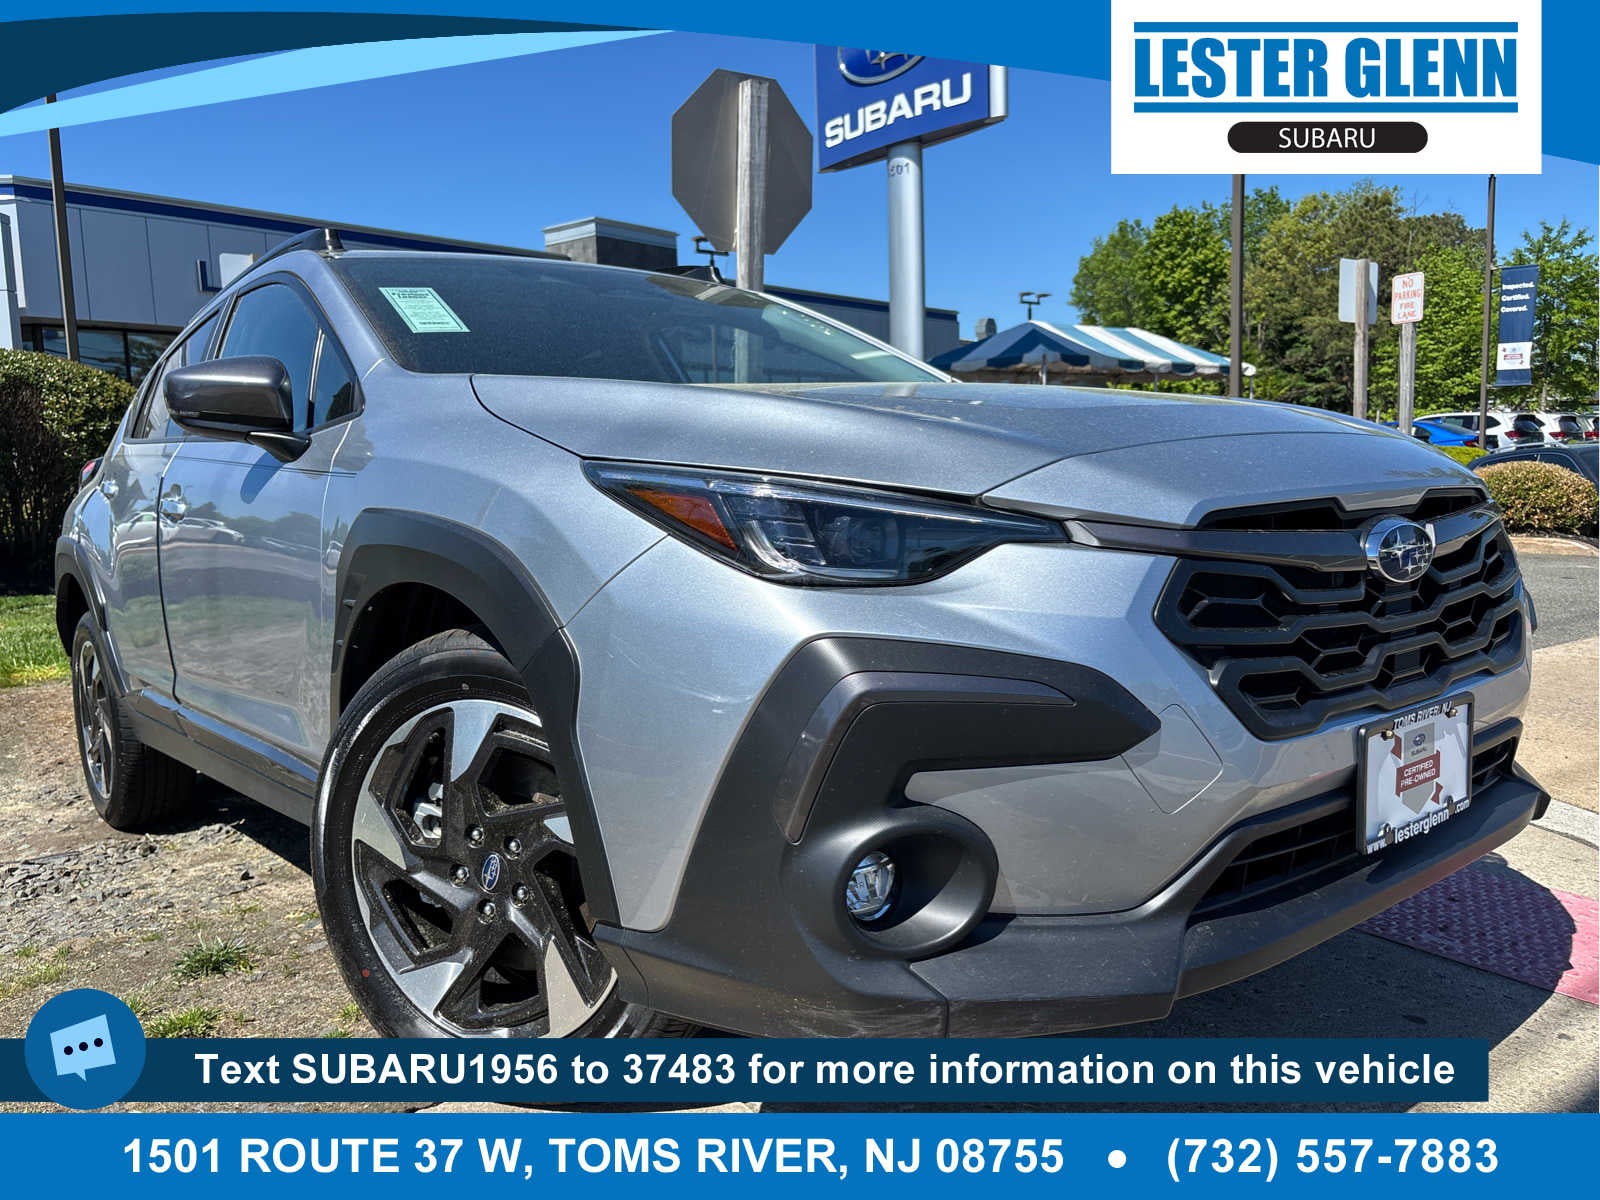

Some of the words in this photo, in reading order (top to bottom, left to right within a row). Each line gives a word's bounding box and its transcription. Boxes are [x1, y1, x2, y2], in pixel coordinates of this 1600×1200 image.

[825, 72, 972, 149] SUBARU
[1402, 278, 1414, 288] NO
[1394, 289, 1421, 302] PARKING
[1501, 293, 1530, 302] Certified.
[1400, 301, 1416, 310] FIRE
[1500, 304, 1528, 313] Covered.
[1397, 310, 1417, 320] LANE
[1394, 712, 1416, 728] TOMS
[1442, 700, 1453, 714] NJ
[1404, 759, 1434, 777] CERTIFIED
[1400, 767, 1436, 789] PRE-OWNED
